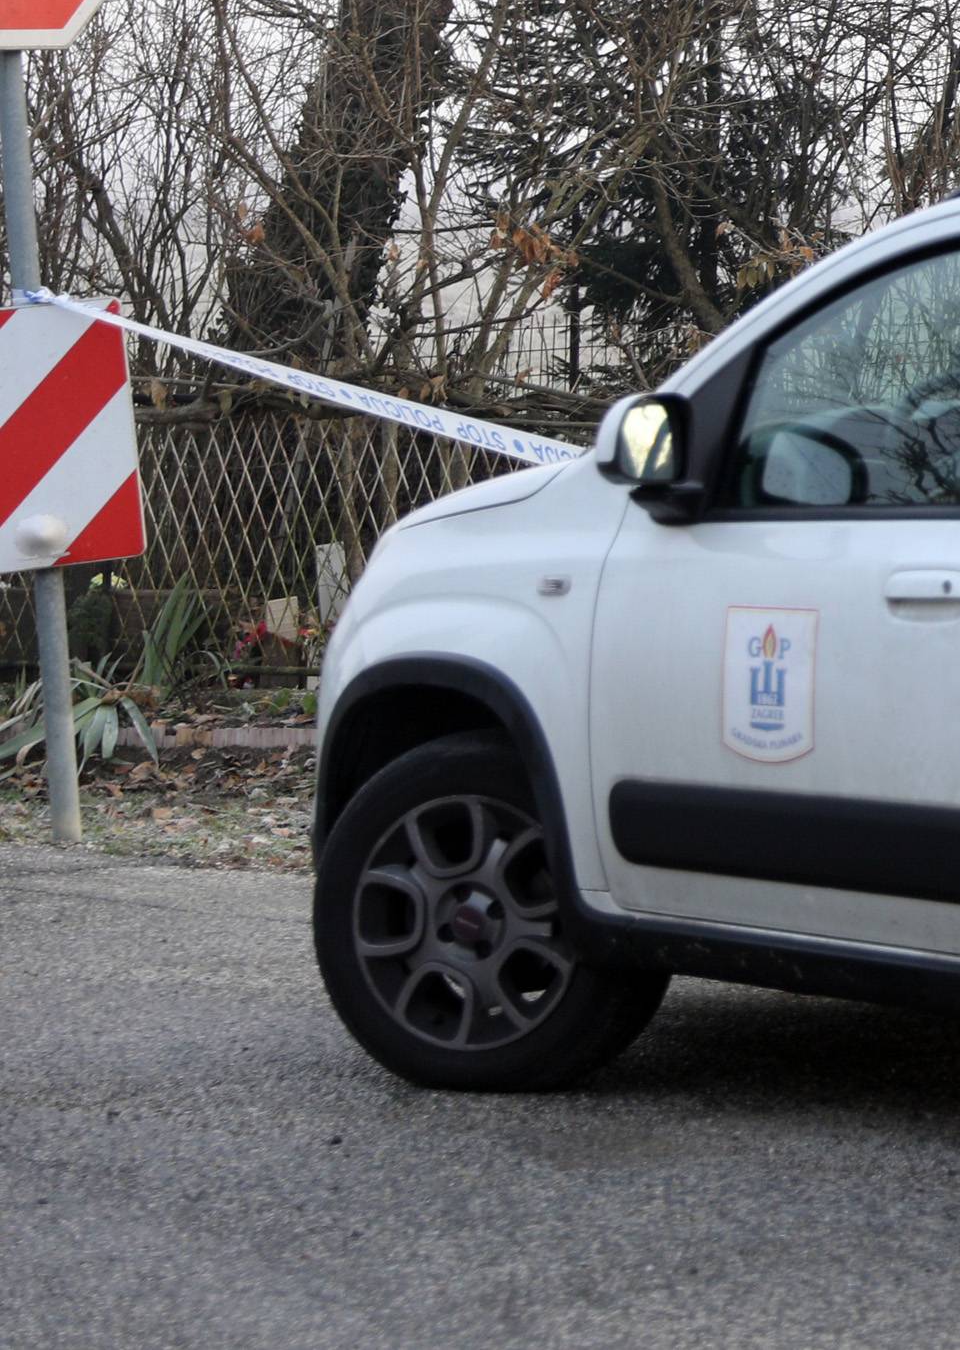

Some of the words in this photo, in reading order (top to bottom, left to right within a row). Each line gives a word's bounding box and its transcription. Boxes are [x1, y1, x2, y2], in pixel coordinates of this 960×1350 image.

[357, 391, 445, 432] POLICIJA
[456, 424, 508, 452] STOP
[778, 638, 792, 660] P
